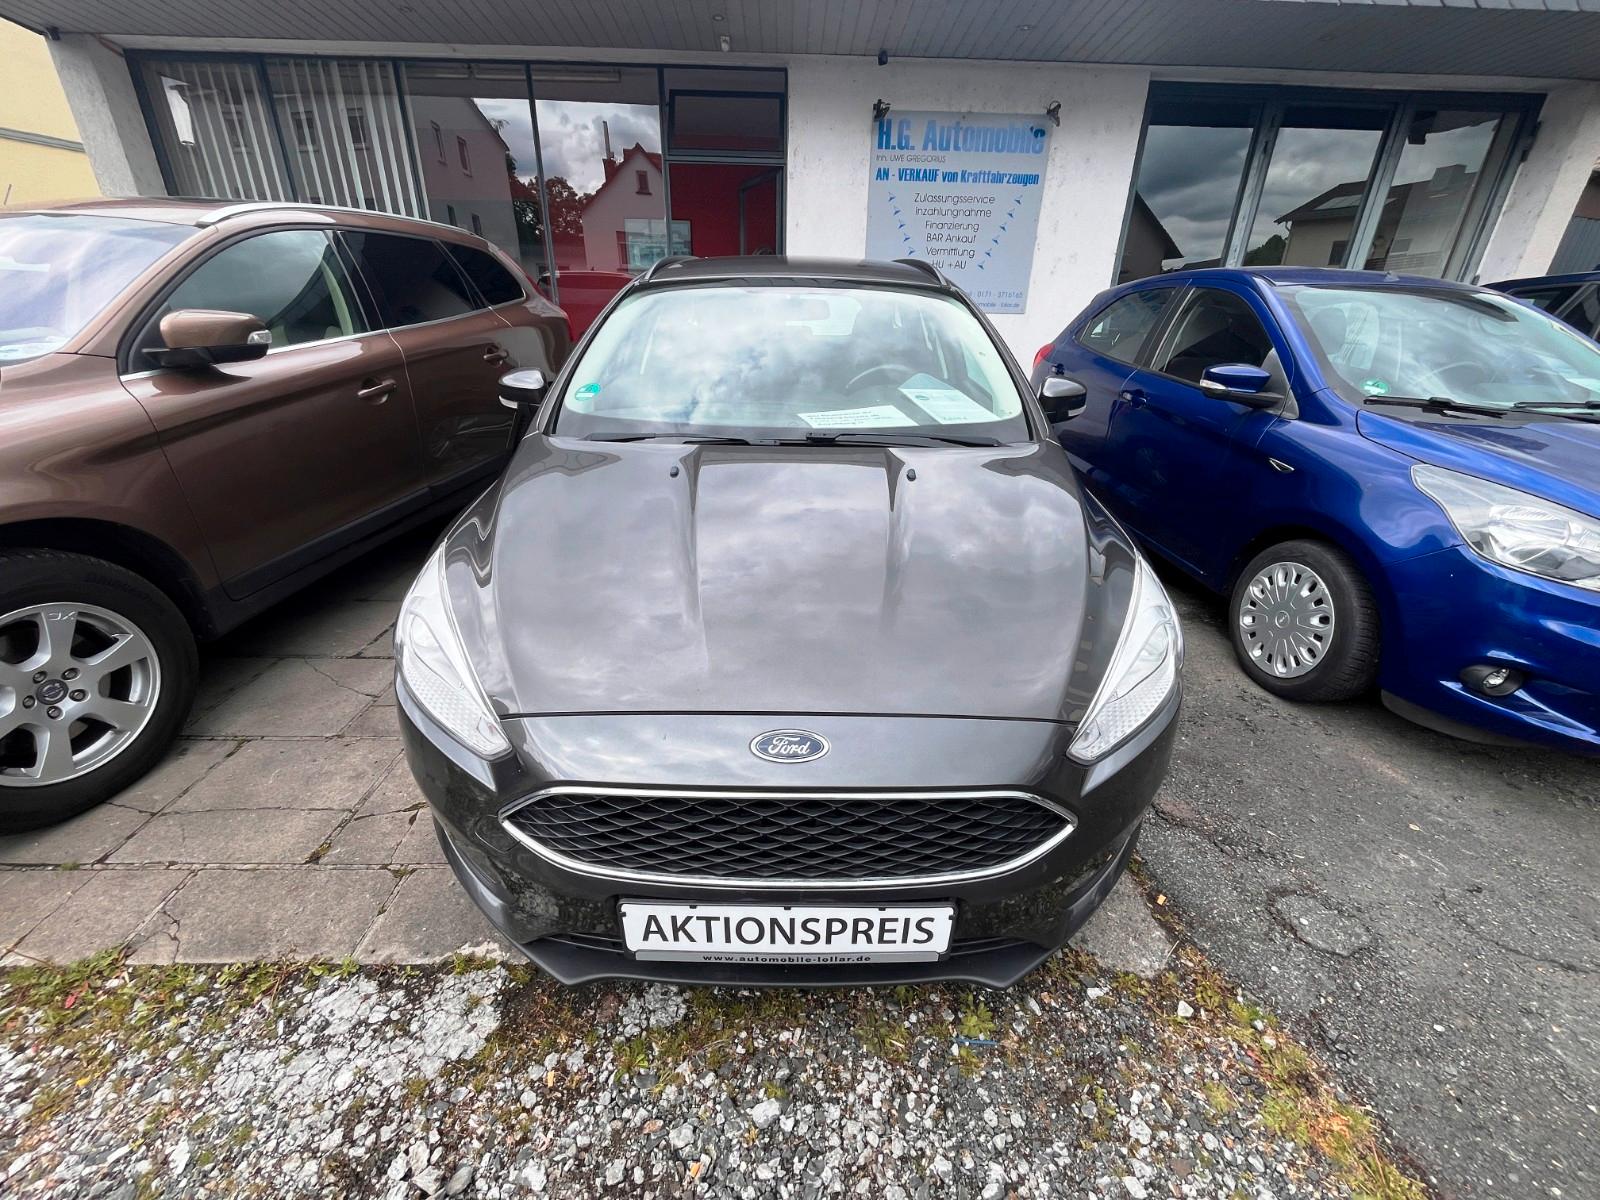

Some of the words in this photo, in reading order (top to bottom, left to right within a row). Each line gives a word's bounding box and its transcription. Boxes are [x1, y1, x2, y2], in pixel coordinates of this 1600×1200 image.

[877, 118, 915, 151] H.G.
[922, 119, 1046, 154] Automobile
[889, 154, 905, 162] UWE
[906, 155, 946, 163] GREGORIUS
[875, 167, 890, 181] AN
[898, 168, 940, 183] VERKAUF
[942, 171, 958, 183] von
[960, 169, 1040, 187] Kraftfahrzeugen
[914, 192, 996, 206] Zulassungsservice
[915, 206, 992, 219] Inzahlungnahme
[925, 220, 980, 233] Finanzierung
[926, 232, 943, 242] BAR
[945, 234, 976, 244] Ankauf
[926, 246, 976, 259] Vermittlung
[767, 736, 810, 755] Ford
[641, 913, 936, 946] AKTIONSPREIS
[702, 954, 872, 964] www.automobile-lollar.de
